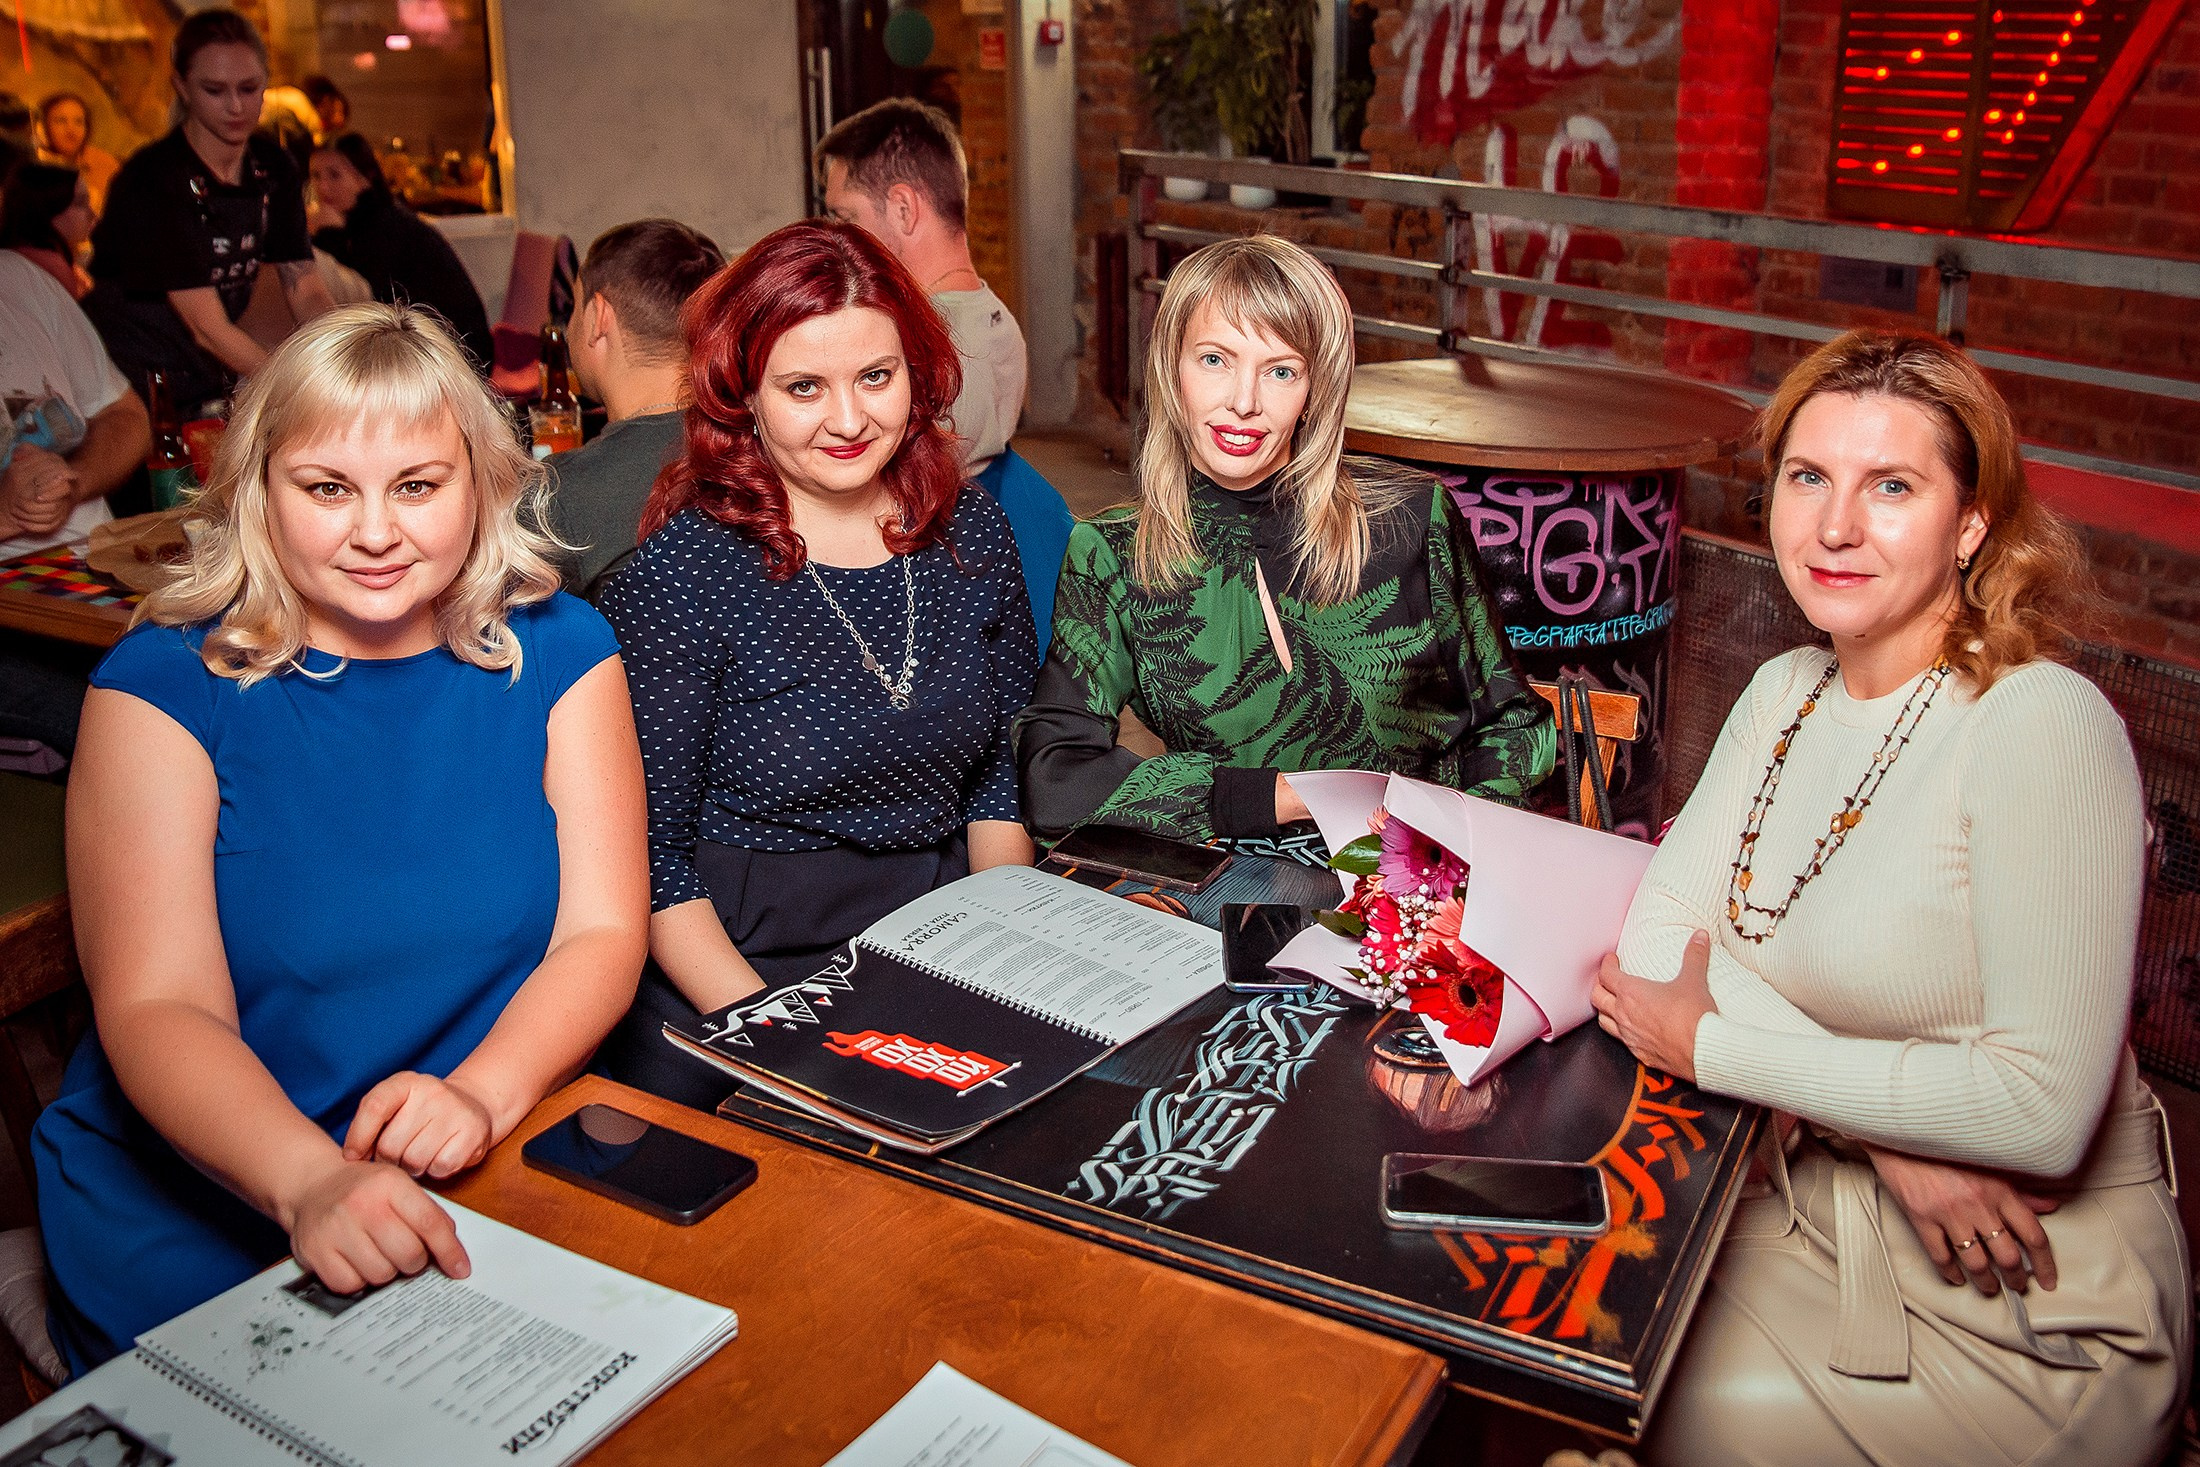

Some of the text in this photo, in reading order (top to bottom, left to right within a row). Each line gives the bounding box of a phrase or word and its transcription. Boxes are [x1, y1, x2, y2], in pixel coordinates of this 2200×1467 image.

[929, 912, 951, 924] PIZZA
[901, 927, 924, 942] BIRRA
[902, 912, 968, 951] CAMORRA
[1125, 1001, 1143, 1013] ПИВО
[871, 1038, 924, 1064] ХО
[902, 1047, 956, 1073] ХО
[934, 1055, 990, 1083] ЙО
[501, 1351, 639, 1455] КОКТЕЙЛИ
